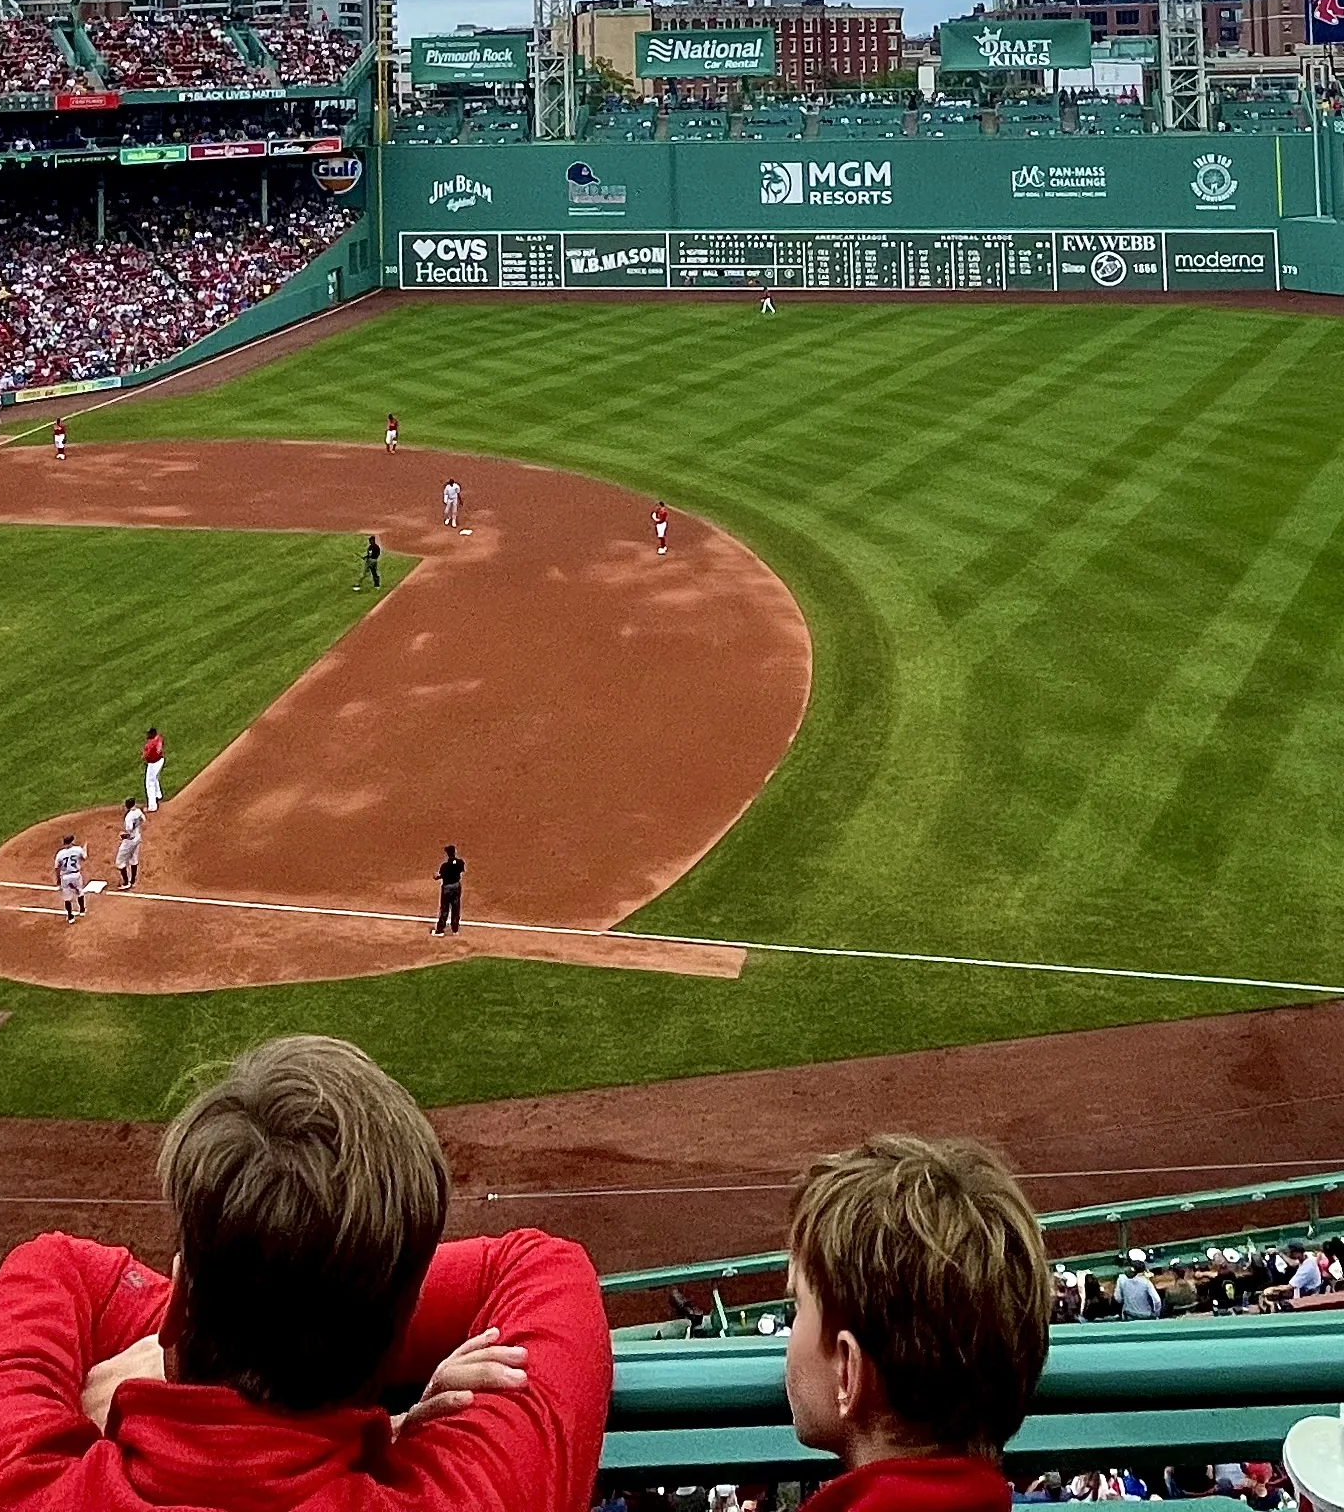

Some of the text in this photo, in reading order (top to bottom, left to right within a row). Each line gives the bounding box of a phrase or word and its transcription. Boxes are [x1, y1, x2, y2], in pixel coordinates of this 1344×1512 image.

[425, 48, 513, 64] Plymouth Rock
[672, 38, 762, 60] National
[980, 38, 1052, 57] DRAFT
[988, 51, 1052, 67] KINGS
[315, 158, 359, 178] Gulf
[808, 160, 893, 187] MGM
[1049, 166, 1106, 177] PAN-MASS
[428, 174, 493, 205] JIM BEAM
[1049, 177, 1106, 188] CHALLENGE
[809, 190, 893, 206] RESORTS
[436, 238, 488, 261] CVS
[1099, 235, 1156, 252] WEBB
[1174, 252, 1265, 268] moderna
[415, 261, 489, 284] Health
